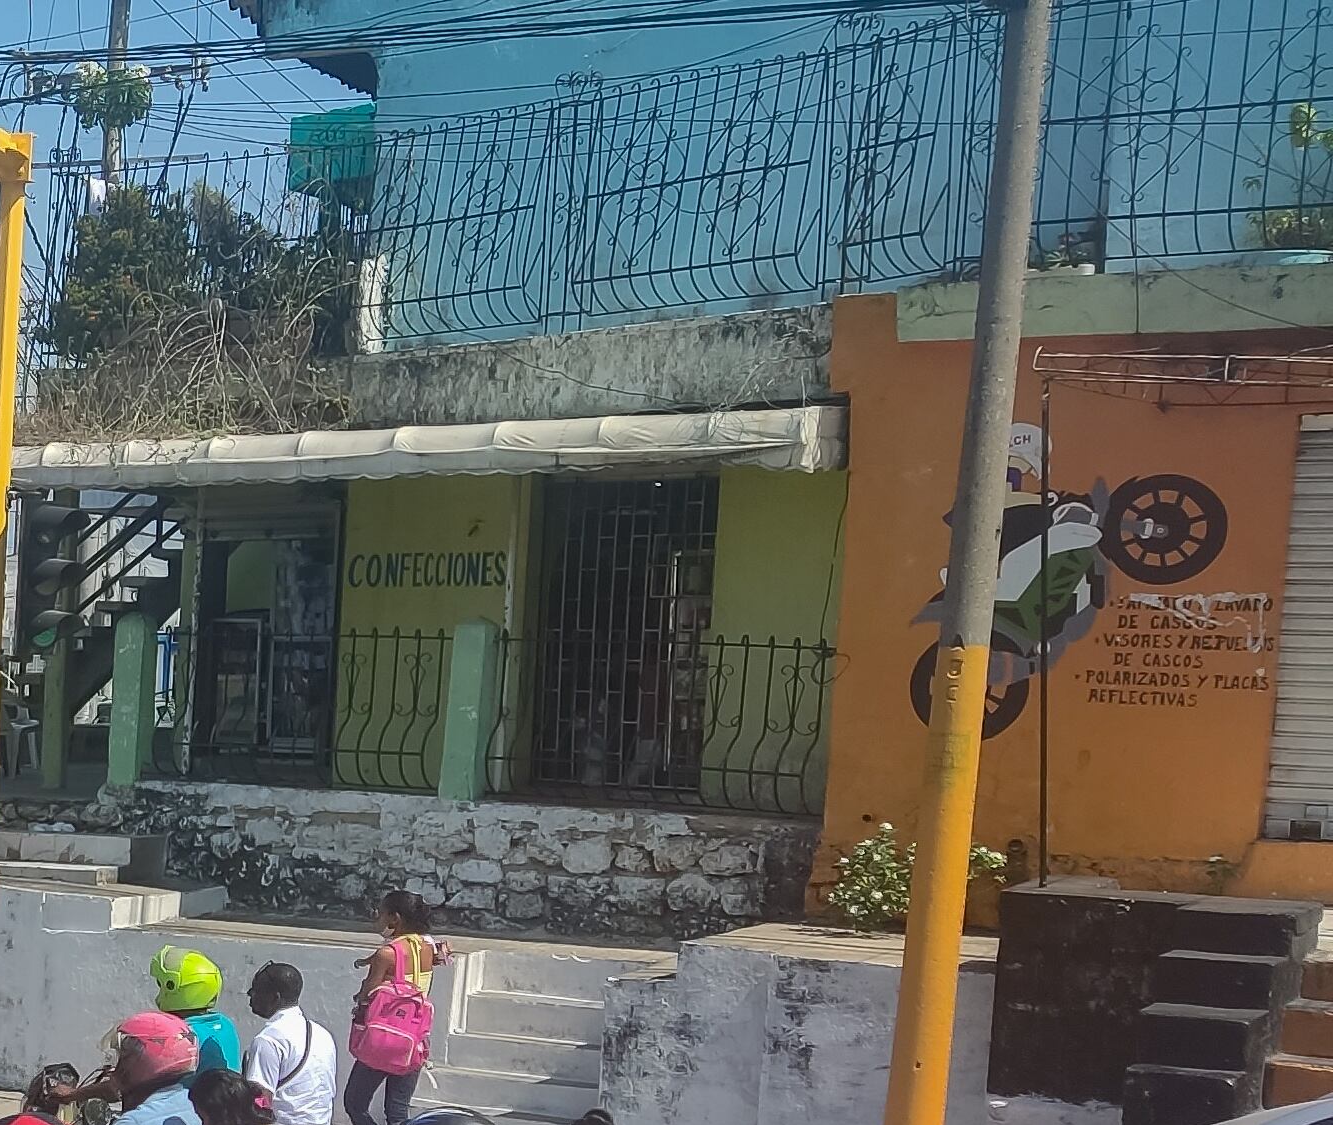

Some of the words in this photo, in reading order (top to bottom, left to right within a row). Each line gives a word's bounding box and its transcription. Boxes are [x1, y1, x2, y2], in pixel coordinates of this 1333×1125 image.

[348, 551, 507, 587] CONFECCIONES
[1117, 614, 1138, 629] DE
[1150, 615, 1218, 630] CASCOS
[1104, 633, 1173, 650] VISORES
[1176, 635, 1189, 650] Y
[1113, 653, 1133, 666] DE
[1143, 653, 1204, 669] CASCOS
[1086, 670, 1190, 688] POLARIZADOS
[1198, 676, 1208, 688] Y
[1214, 675, 1270, 690] PLACAS
[1088, 689, 1198, 708] REFLECTIVAS
